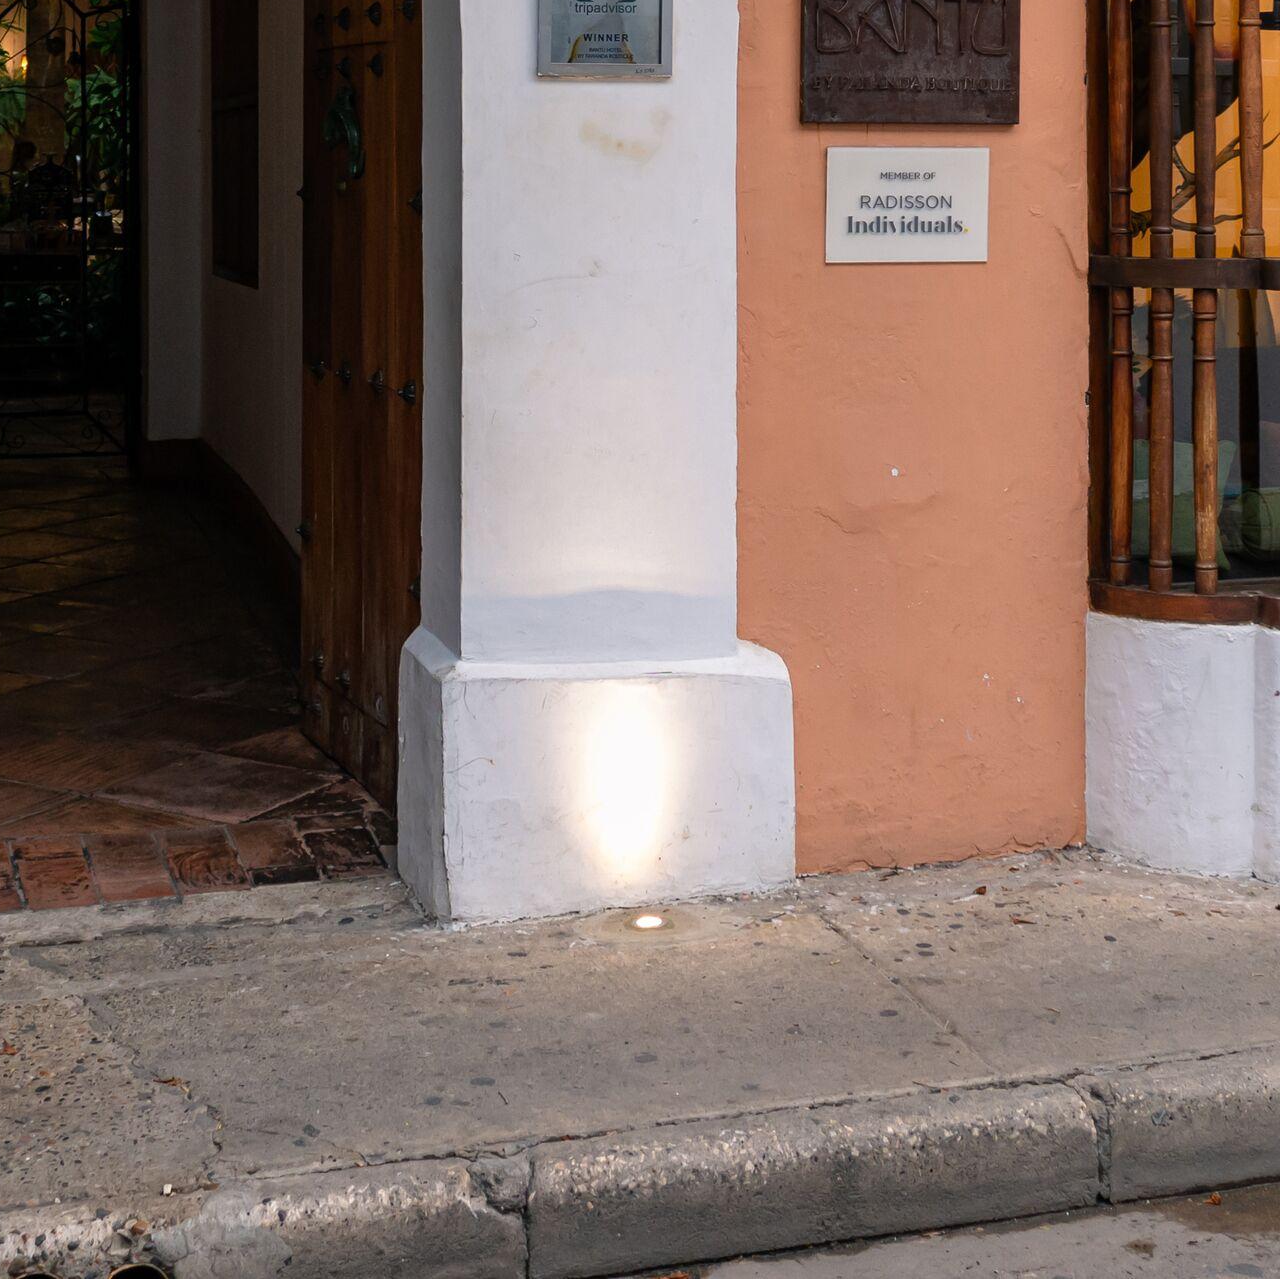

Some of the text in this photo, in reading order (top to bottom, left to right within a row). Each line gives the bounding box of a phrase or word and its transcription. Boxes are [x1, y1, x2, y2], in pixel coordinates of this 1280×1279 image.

[575, 2, 637, 15] tripadvisor
[583, 33, 629, 42] WINNER
[880, 171, 936, 181] MEMBER OF
[859, 194, 953, 210] RADISSON
